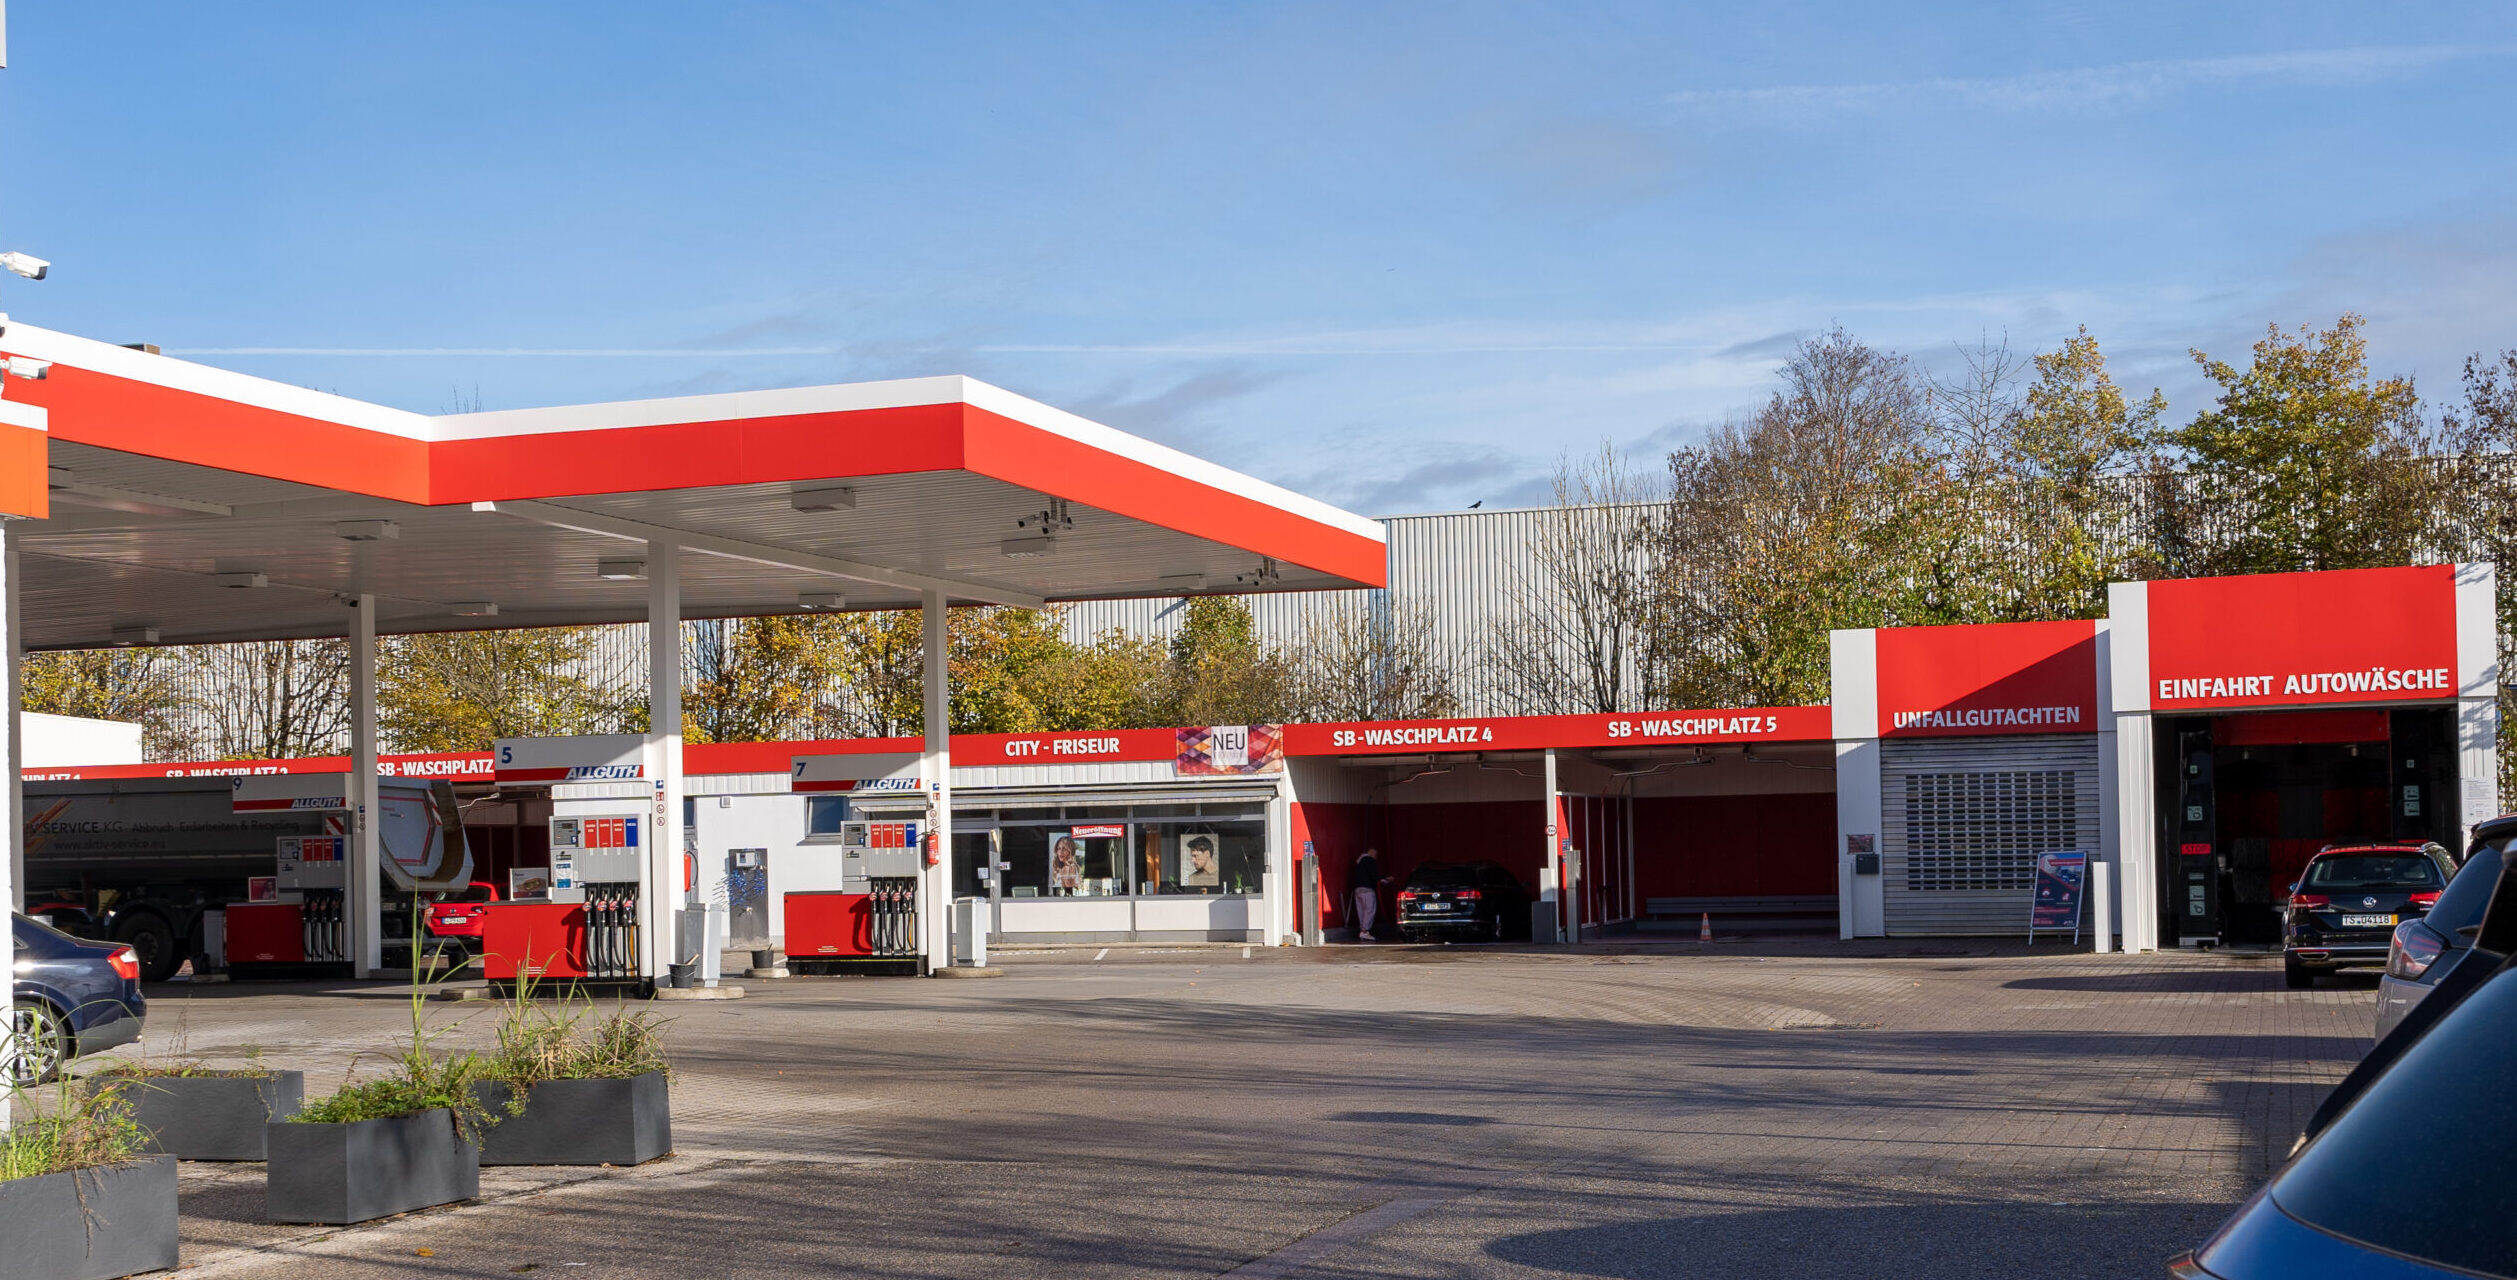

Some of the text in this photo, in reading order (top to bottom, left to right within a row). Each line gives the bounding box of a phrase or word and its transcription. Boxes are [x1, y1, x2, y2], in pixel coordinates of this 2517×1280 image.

[2159, 667, 2449, 700] EINFAHRT AUTOWÄSCHE
[1766, 716, 1777, 732] 5
[1893, 706, 2080, 729] UNFALLGUTACHTEN
[1213, 733, 1245, 751] NEU
[1482, 727, 1493, 742] 4
[1005, 740, 1040, 757] CITY
[1053, 737, 1120, 755] FRISEUR
[501, 746, 512, 764] 5
[564, 765, 640, 780] ALLGUTH
[796, 762, 806, 777] 7
[233, 777, 242, 790] 9
[852, 778, 918, 791] ALLGUTH
[291, 797, 342, 809] ALLGUTH
[43, 822, 100, 834] SERVICE
